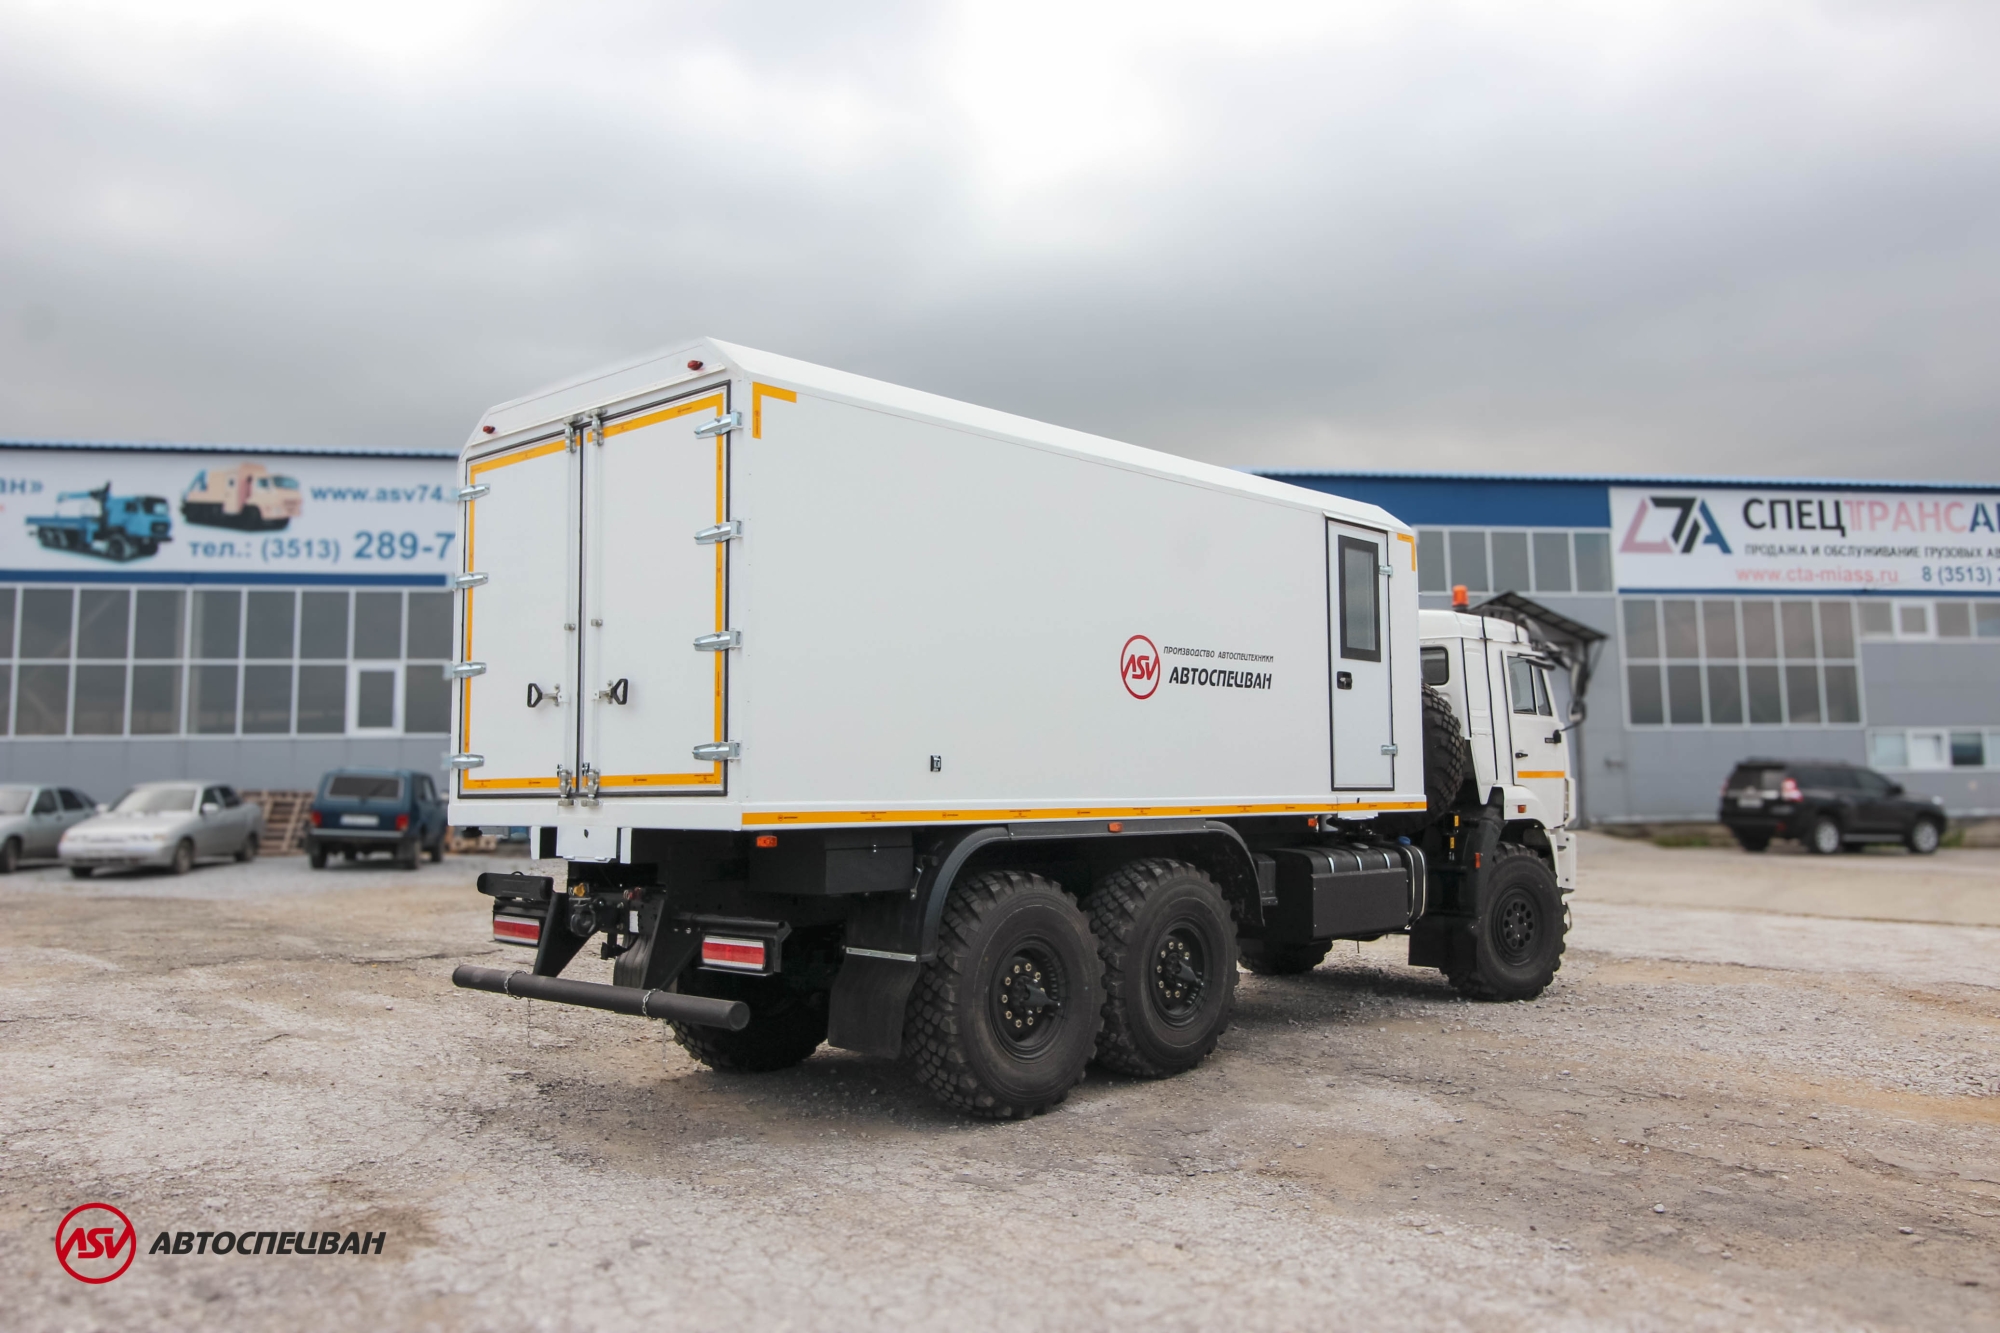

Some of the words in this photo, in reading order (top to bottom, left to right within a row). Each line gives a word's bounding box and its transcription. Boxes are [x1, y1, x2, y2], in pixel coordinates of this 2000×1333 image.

[1742, 498, 2000, 538] СПЕЦТРАНСА
[261, 537, 341, 564] (3513)
[1745, 544, 1807, 558] ПРОДАЖА
[1811, 544, 1821, 557] И
[1824, 545, 1920, 558] ОБСЛУЖИВАНИЕ
[1924, 546, 1982, 559] ГРУЗОВЫХ
[1735, 565, 1898, 584] www.cta-miass.ru
[1922, 565, 1933, 582] 8
[1938, 565, 1992, 586] (3513)
[1163, 646, 1216, 658] ПРОИЗВОДСТВО
[1217, 651, 1274, 663] АВТОСПЕЦТЕХНИКИ
[1169, 666, 1273, 690] АВТОСПЕЦВАН
